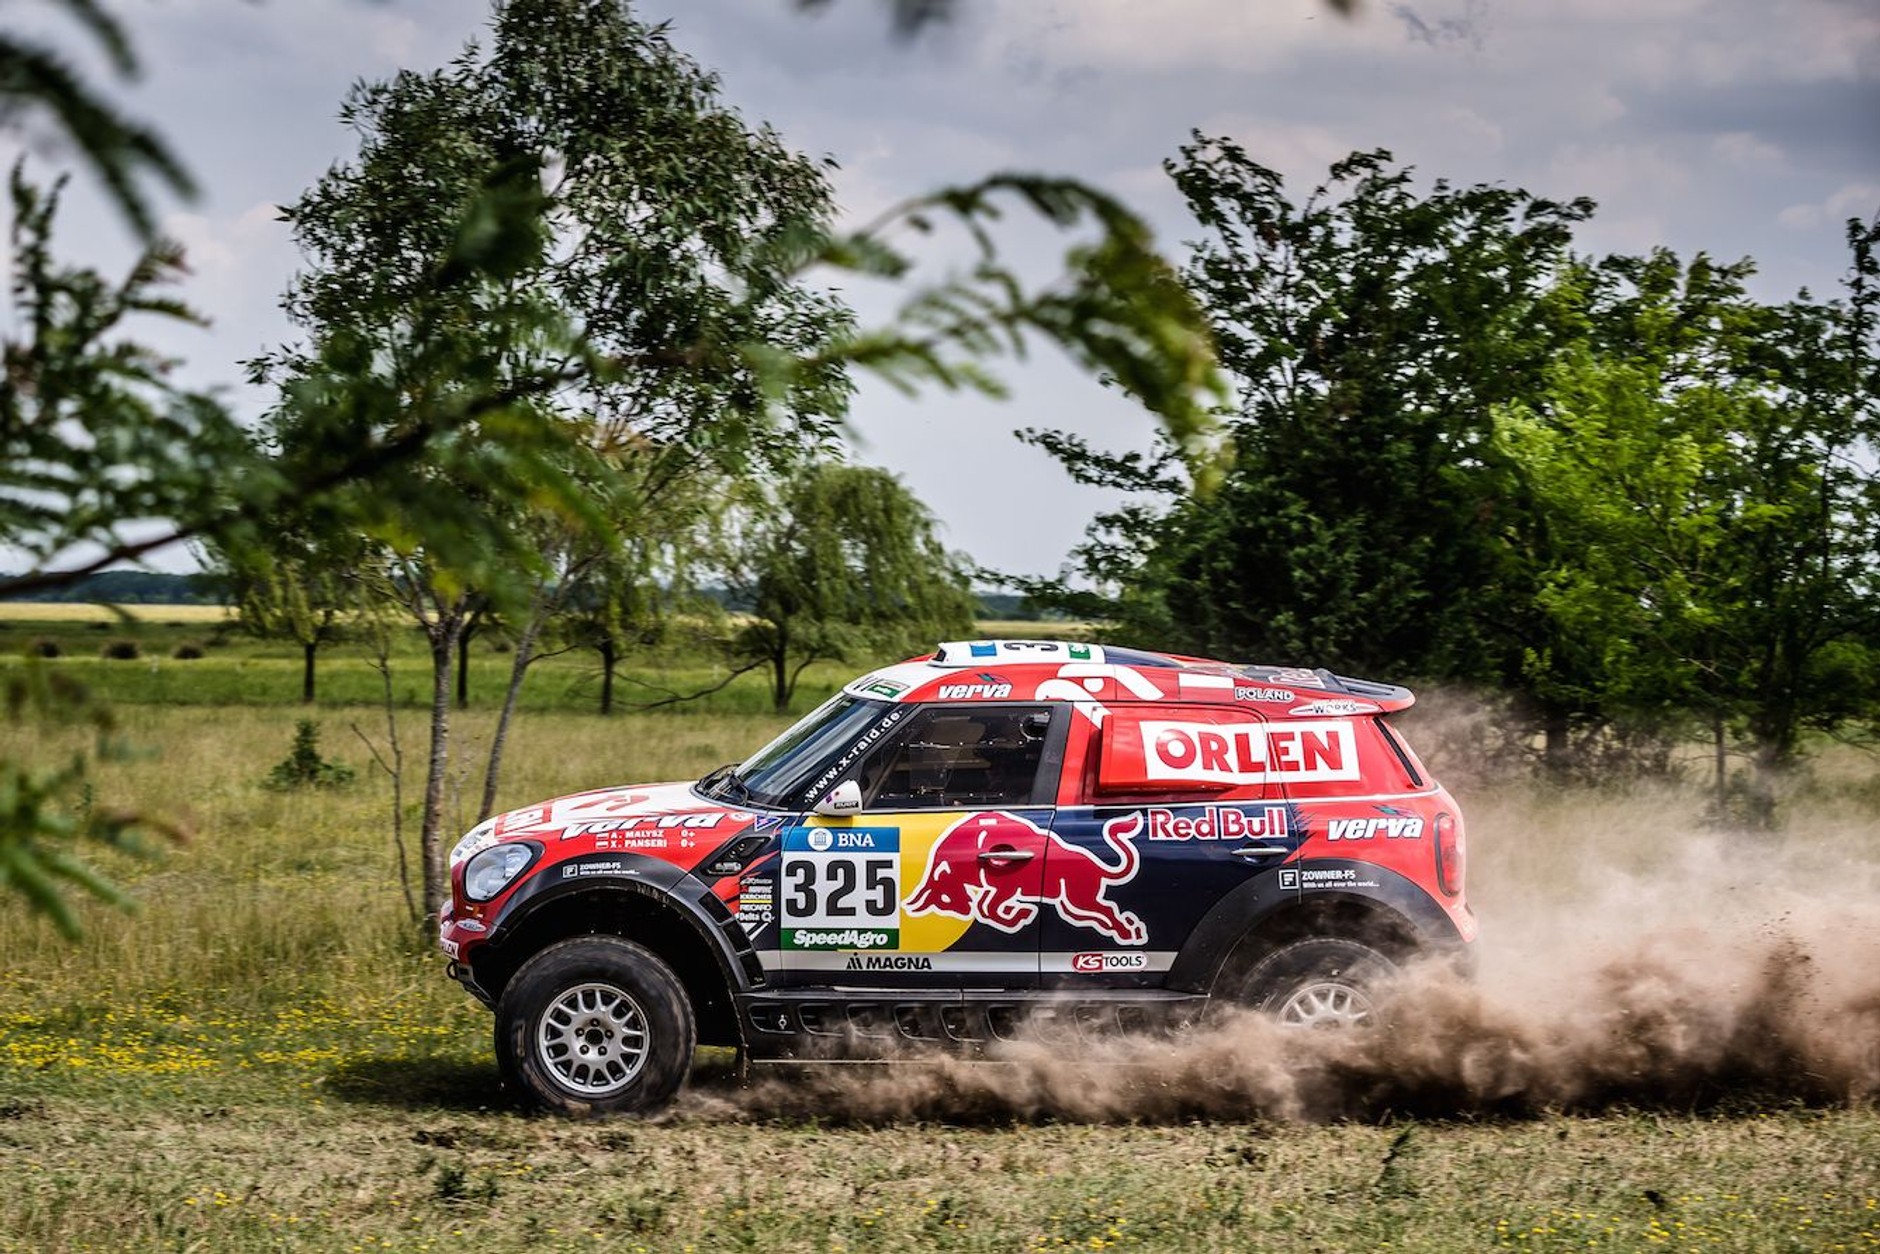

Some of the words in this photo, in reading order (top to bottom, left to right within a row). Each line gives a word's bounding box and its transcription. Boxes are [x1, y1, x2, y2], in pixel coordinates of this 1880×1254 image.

[938, 682, 1012, 699] verva
[1235, 687, 1295, 701] POLAND
[1312, 701, 1357, 714] WORKS
[1155, 728, 1343, 773] ORLEN
[1149, 807, 1217, 841] Red
[1220, 806, 1288, 840] Bull
[1327, 817, 1424, 841] verva
[625, 830, 664, 838] MALYSZ
[837, 832, 876, 848] BNA
[624, 840, 667, 848] PANSERI
[1302, 870, 1356, 880] ZOWNER-FS
[784, 859, 897, 917] 325
[793, 930, 888, 949] SpeedAgro
[866, 957, 932, 970] MAGNA
